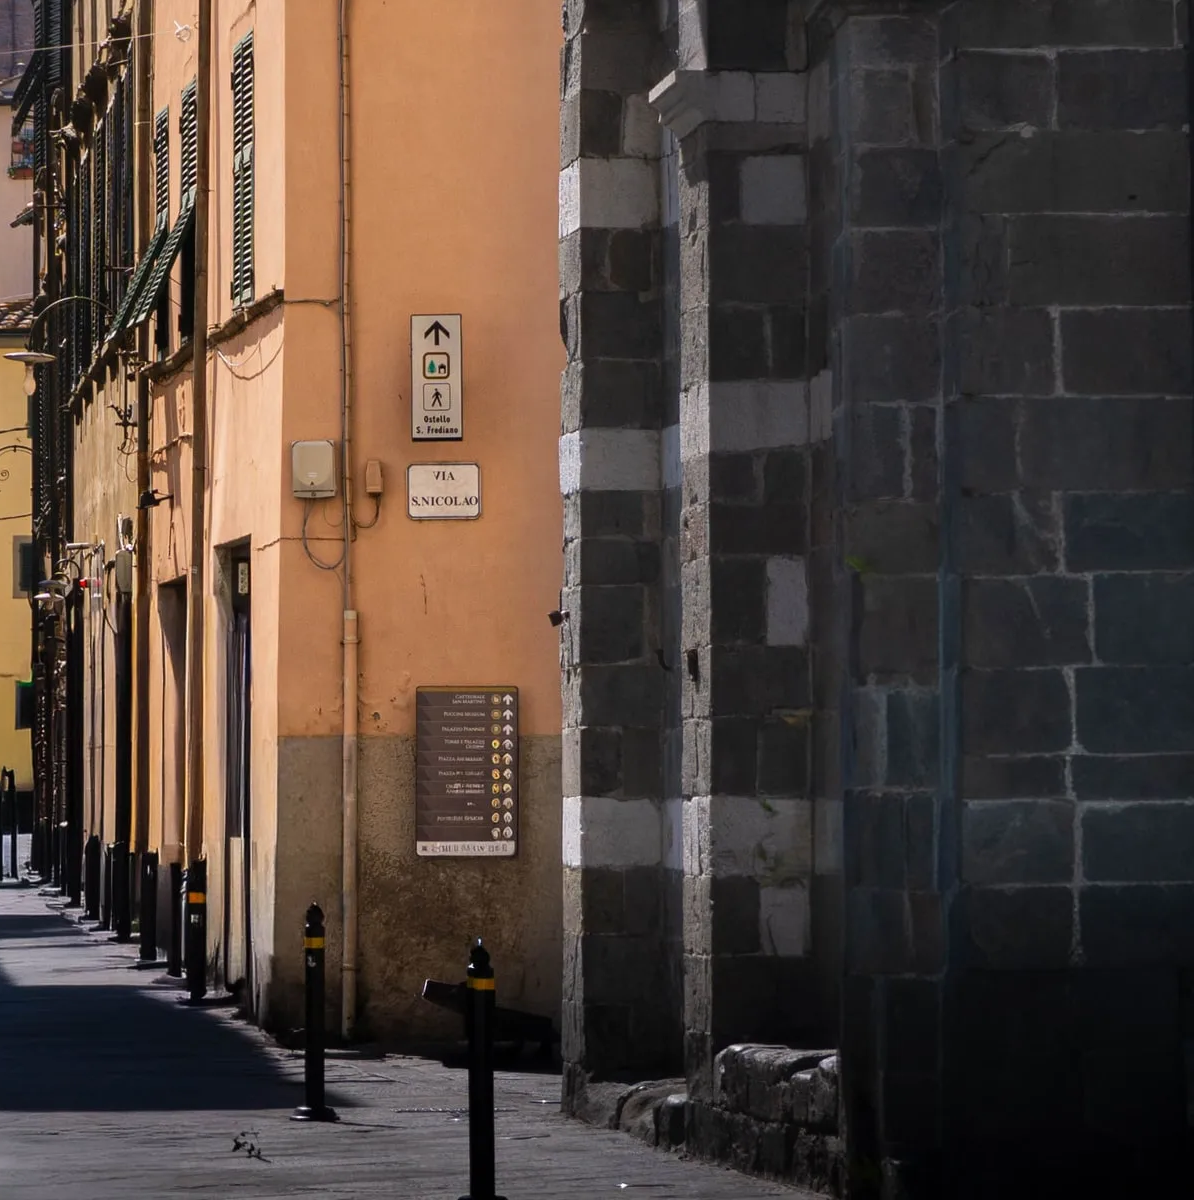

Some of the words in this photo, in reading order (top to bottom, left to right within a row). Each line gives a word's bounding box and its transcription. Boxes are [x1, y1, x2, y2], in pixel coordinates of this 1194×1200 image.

[423, 415, 451, 423] Ostello
[416, 426, 424, 434] S.
[427, 425, 459, 434] Frediano
[432, 471, 455, 480] VIA
[411, 495, 478, 506] S.NICOLAO
